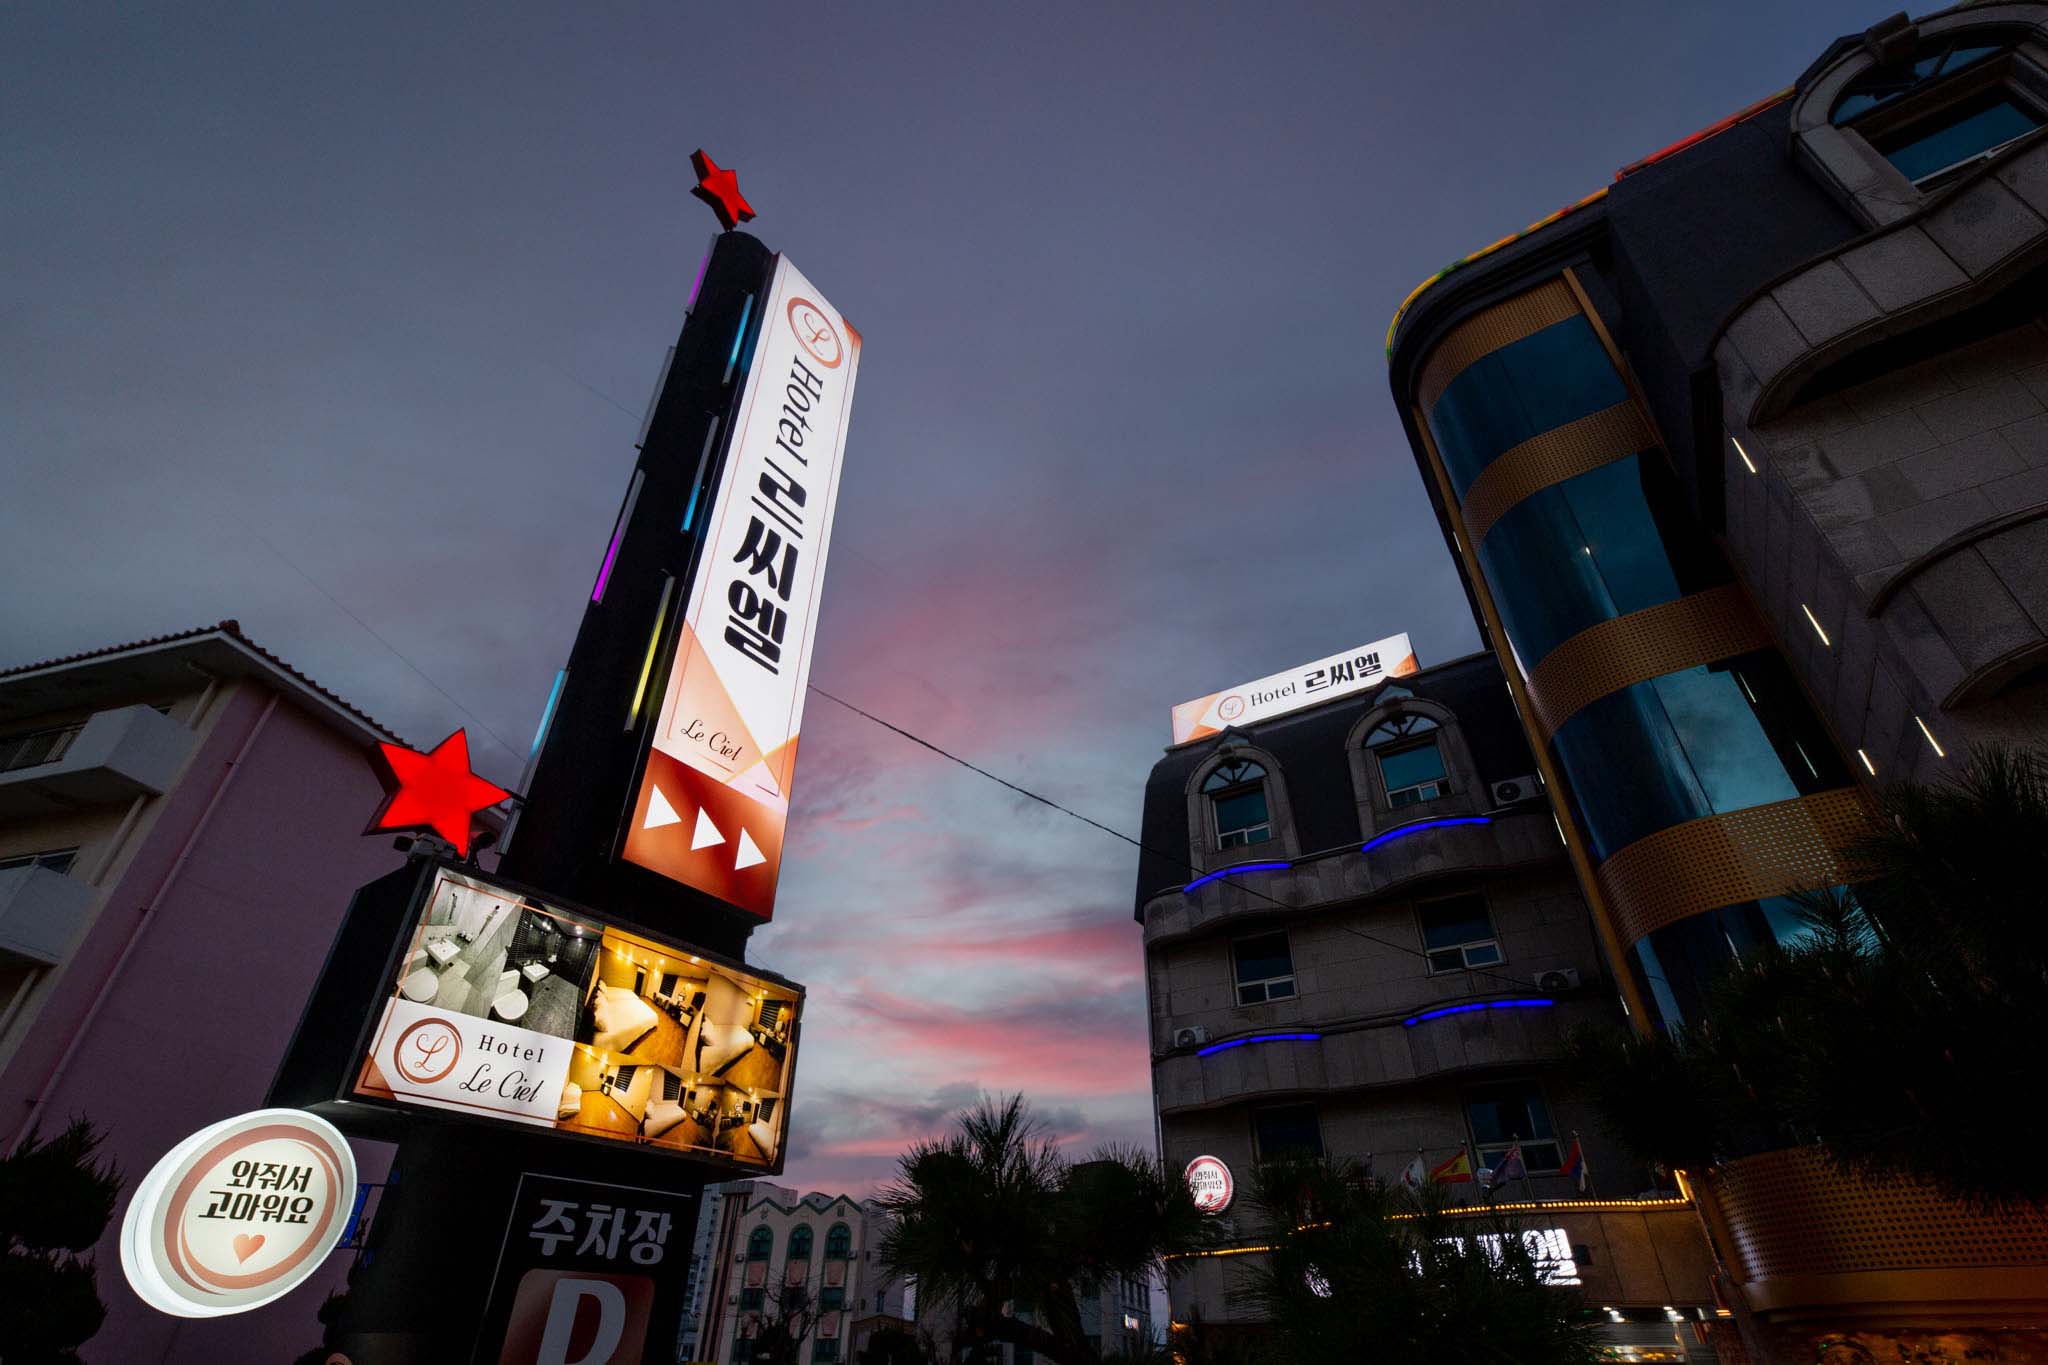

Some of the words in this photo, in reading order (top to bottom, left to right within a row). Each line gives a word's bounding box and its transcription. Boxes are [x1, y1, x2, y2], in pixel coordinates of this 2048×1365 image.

[775, 354, 823, 468] Hotel
[724, 456, 807, 676] 르씨엘
[1250, 681, 1297, 707] Hotel
[1304, 651, 1383, 695] 르씨엘
[680, 718, 705, 743] Le
[708, 730, 743, 762] Ciel
[478, 1033, 546, 1064] Hotel
[459, 1061, 492, 1094] Le
[498, 1069, 546, 1103] Ciel
[226, 1160, 313, 1193] 와줘서
[198, 1190, 314, 1224] 고마워요
[529, 1199, 673, 1265] 주차장
